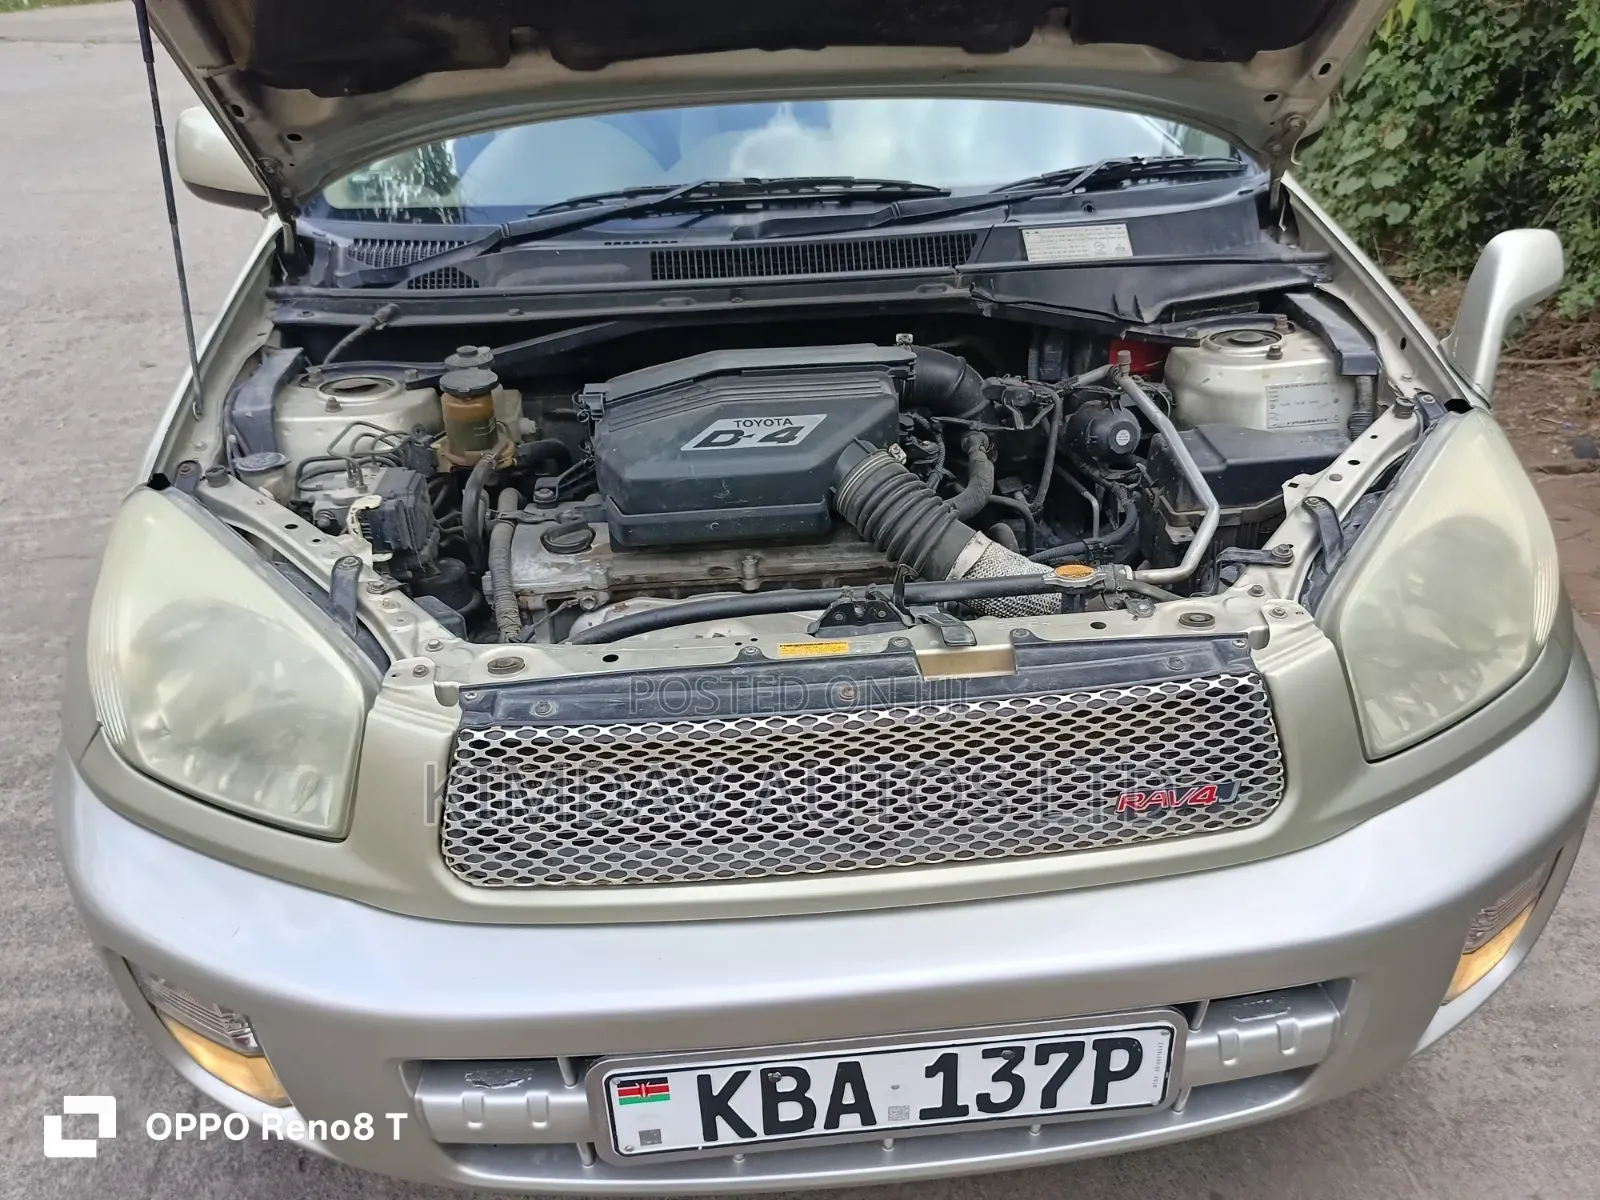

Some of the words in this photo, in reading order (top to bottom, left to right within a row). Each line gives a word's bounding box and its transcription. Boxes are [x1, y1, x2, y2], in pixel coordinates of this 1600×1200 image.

[733, 417, 794, 428] TOYOTA
[692, 425, 806, 449] D-4
[1116, 784, 1220, 813] RAV4
[696, 1060, 878, 1142] KBA
[918, 1036, 1144, 1121] 137P
